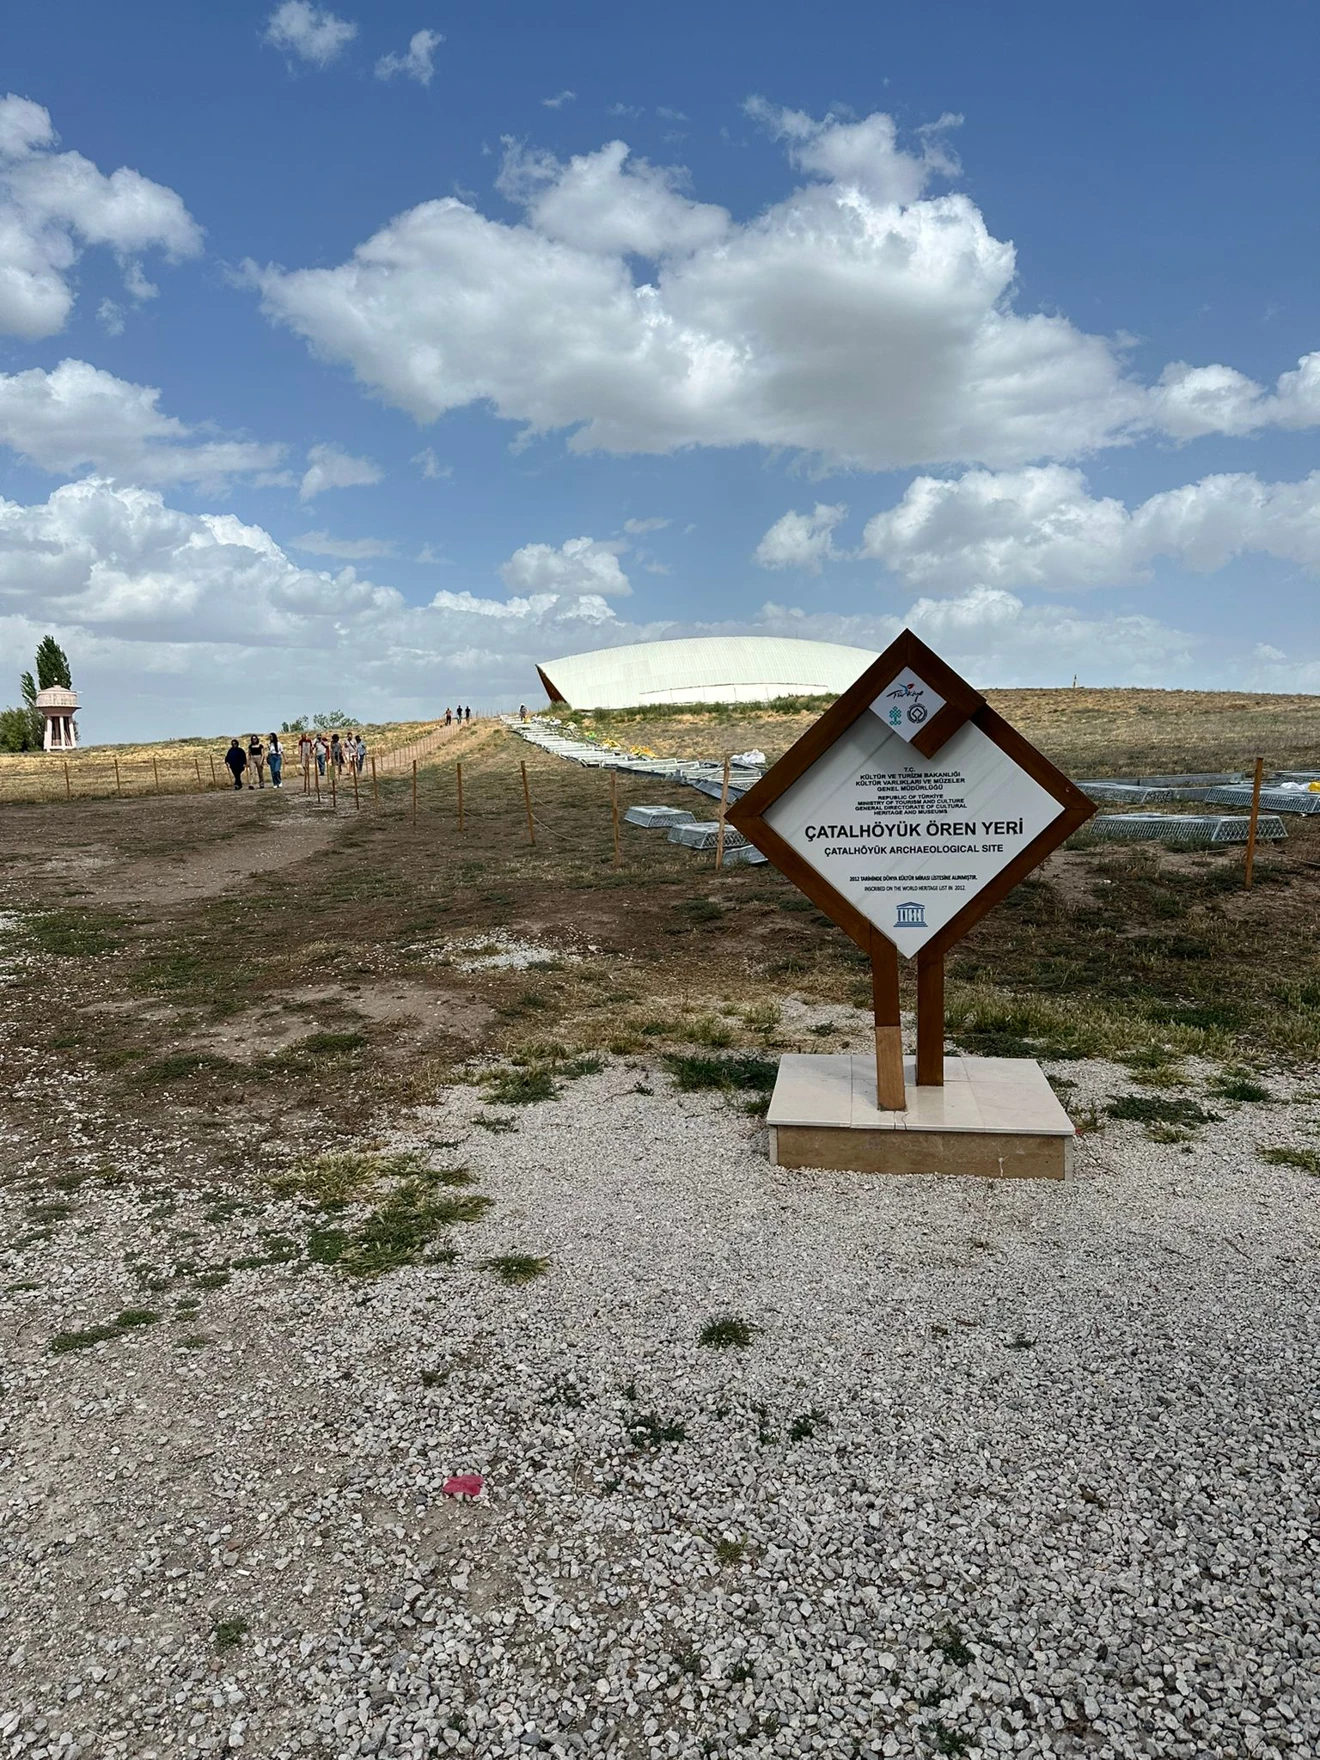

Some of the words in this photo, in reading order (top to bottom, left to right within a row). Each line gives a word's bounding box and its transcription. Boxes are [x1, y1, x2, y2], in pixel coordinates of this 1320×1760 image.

[805, 821, 921, 842] ÇATALHÖYÜK
[926, 820, 976, 836] ÖREN
[981, 817, 1024, 835] YERİ
[824, 844, 888, 857] ÇATALHÖYÜK
[889, 844, 979, 854] ARCHAEOLOGICAL
[982, 844, 1004, 853] SITE
